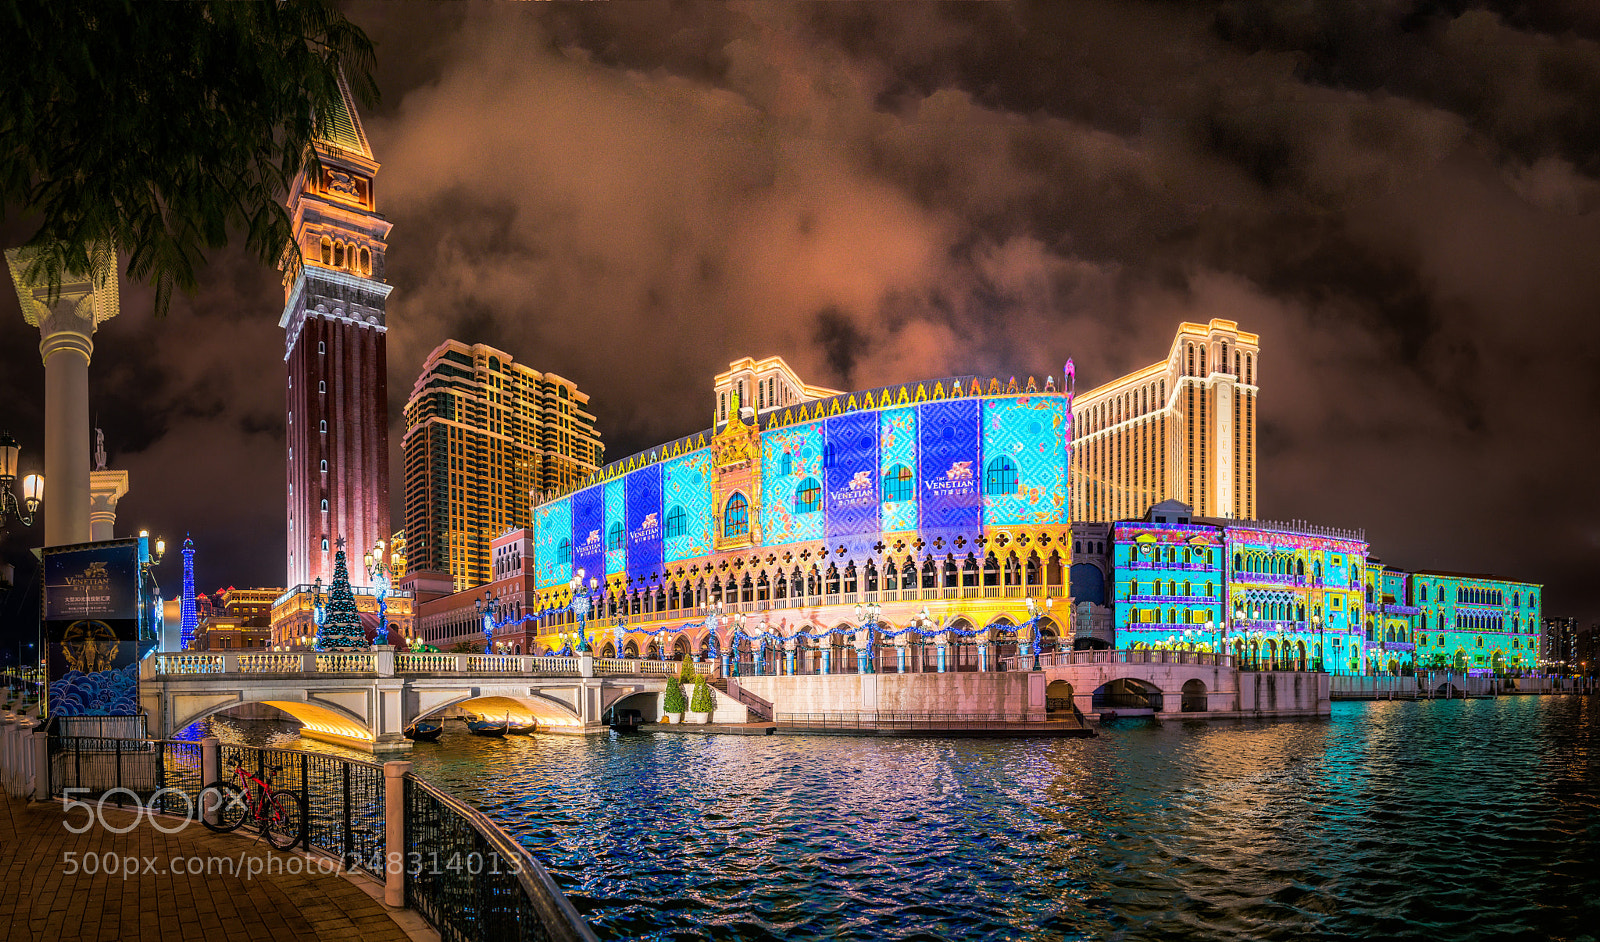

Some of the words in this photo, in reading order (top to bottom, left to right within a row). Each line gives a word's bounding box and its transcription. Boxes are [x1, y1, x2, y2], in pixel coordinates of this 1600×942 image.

[924, 480, 975, 490] VENETIAN
[829, 489, 874, 501] VENETIAN
[629, 527, 659, 540] VENETIAN
[64, 577, 109, 585] VENETIAN
